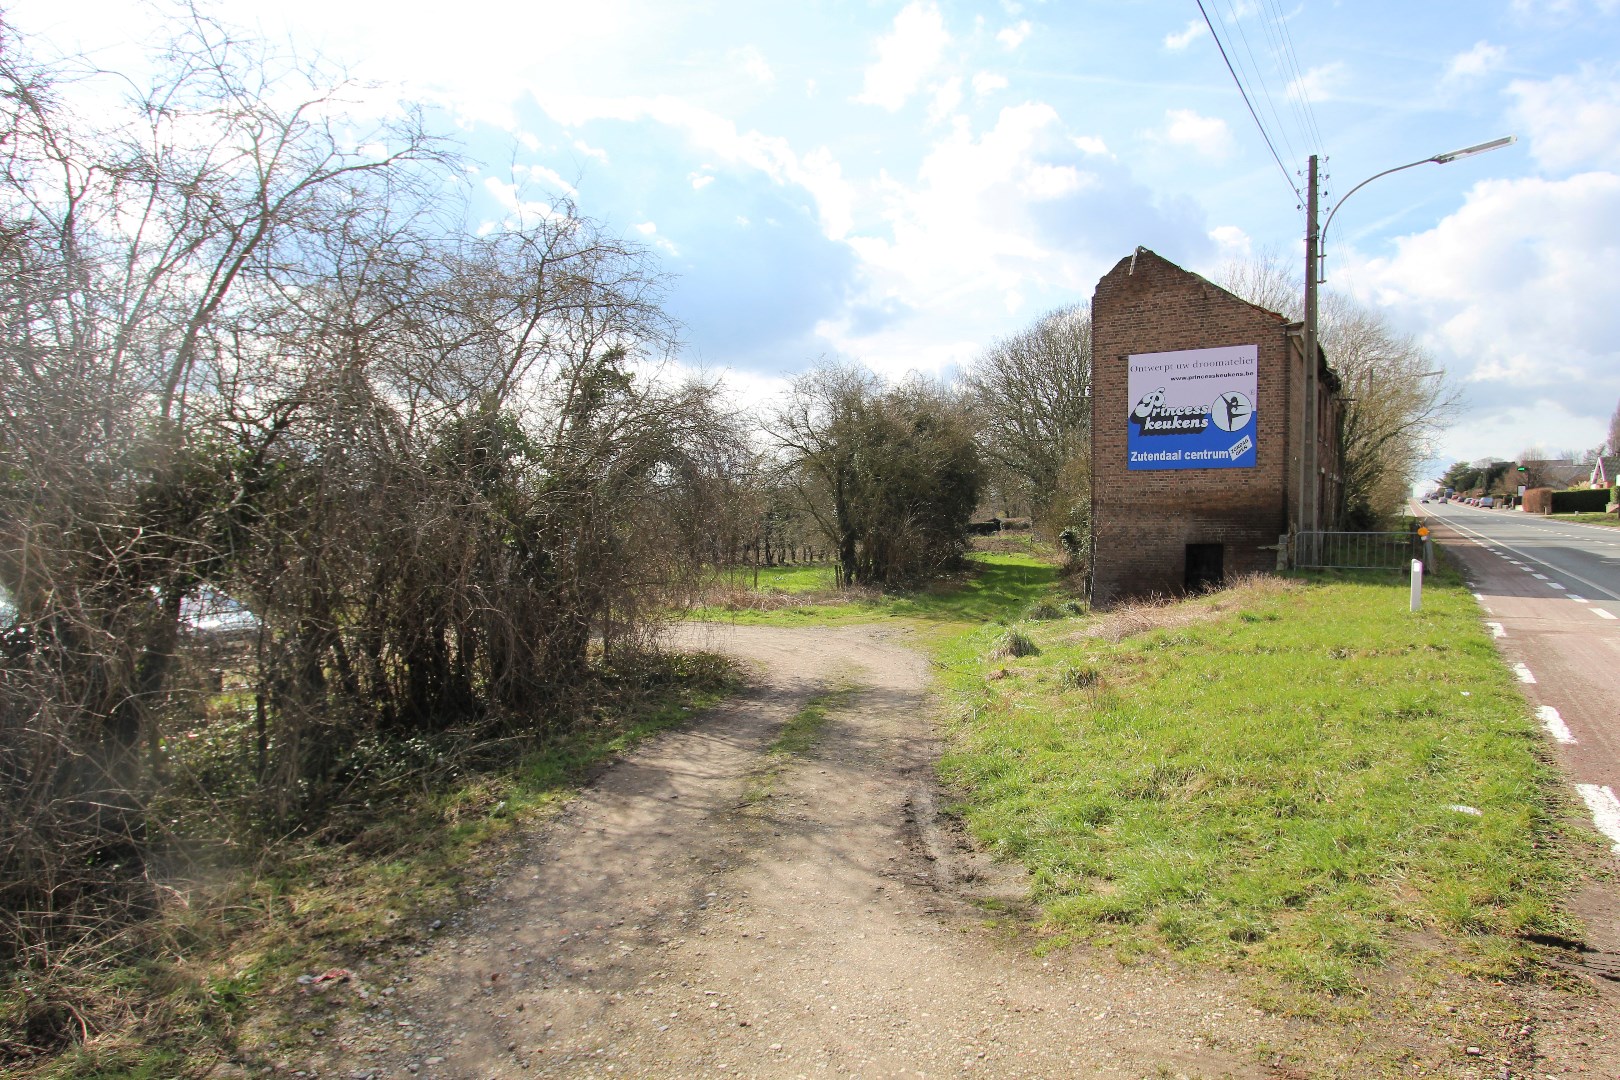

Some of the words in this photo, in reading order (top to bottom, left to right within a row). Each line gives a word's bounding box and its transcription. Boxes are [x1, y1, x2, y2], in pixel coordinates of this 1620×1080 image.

[1192, 357, 1255, 368] droomatelier
[1170, 371, 1254, 381] www.princesskeukens.be
[1134, 387, 1209, 417] Princess
[1144, 416, 1209, 430] keukens
[1130, 450, 1182, 462] Zutendaal
[1184, 449, 1229, 460] centrum
